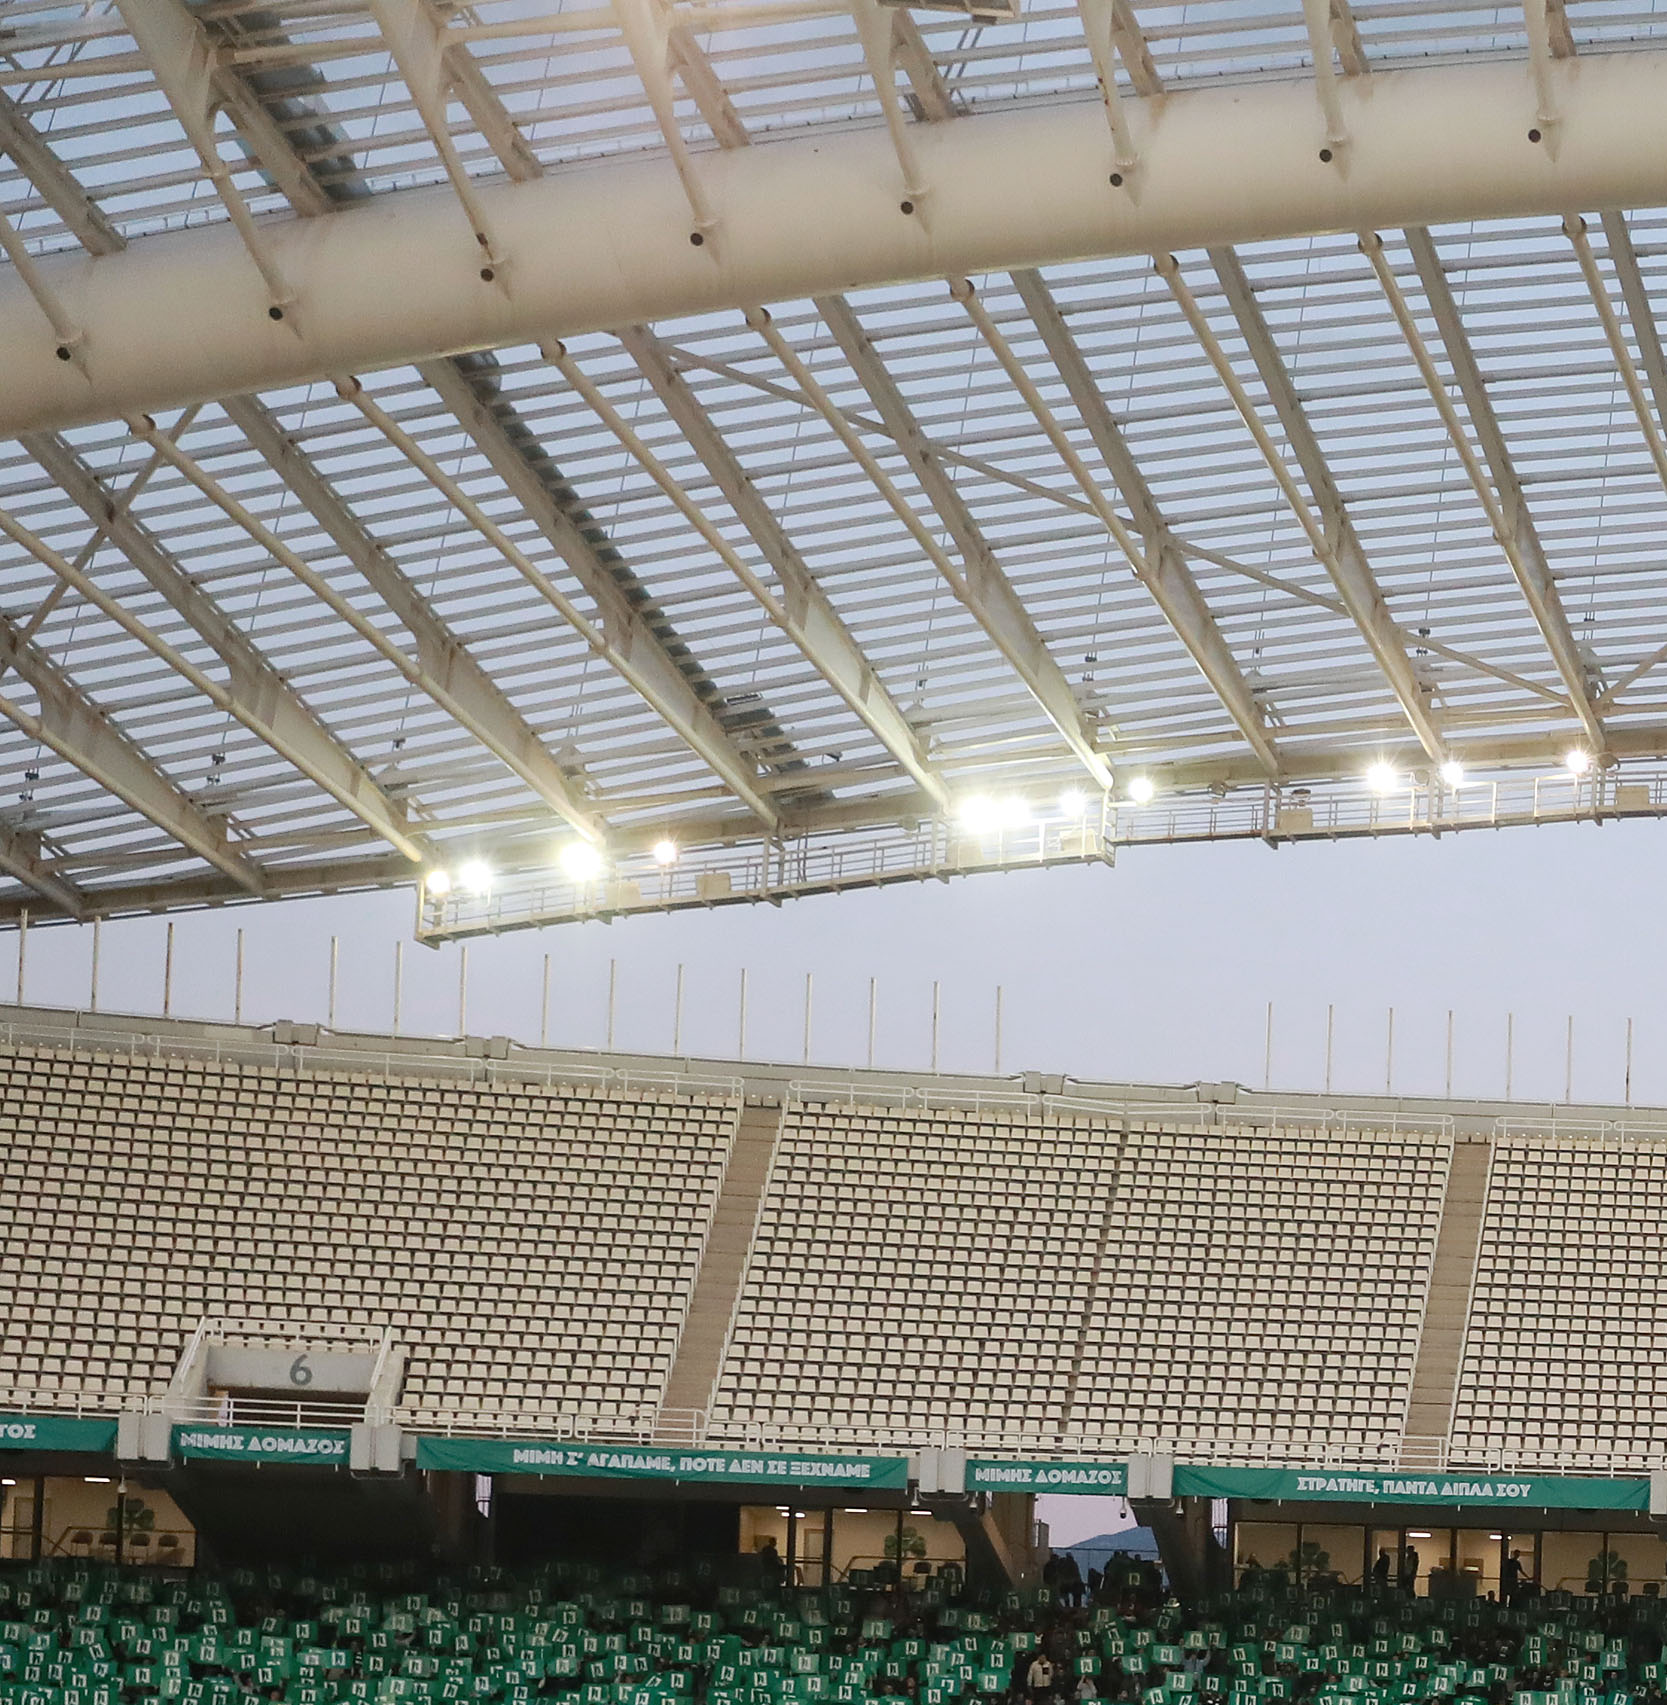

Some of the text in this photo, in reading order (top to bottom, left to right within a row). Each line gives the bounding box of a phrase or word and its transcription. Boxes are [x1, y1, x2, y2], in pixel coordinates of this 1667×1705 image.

[290, 1353, 313, 1386] 6
[181, 1432, 345, 1454] ΜΙΜΗΣ ΔΟΜΑΖΟΣ
[513, 1449, 563, 1465] ΜΙΜΗ
[679, 1457, 725, 1473] ΠΟΤΕ
[728, 1458, 763, 1475] ΔΕΝ
[766, 1459, 787, 1475] ΣΕ
[790, 1461, 871, 1478] ΞΕΧΝΑΜΕ
[975, 1467, 1122, 1485] ΜΙΜΗΣ ΔΟΜΑΖΟΣ
[1383, 1480, 1438, 1495] ΠΑΝΤΑ
[1440, 1482, 1493, 1497] ΔΙΠΛΑ
[1496, 1483, 1531, 1497] ΣΟΥ
